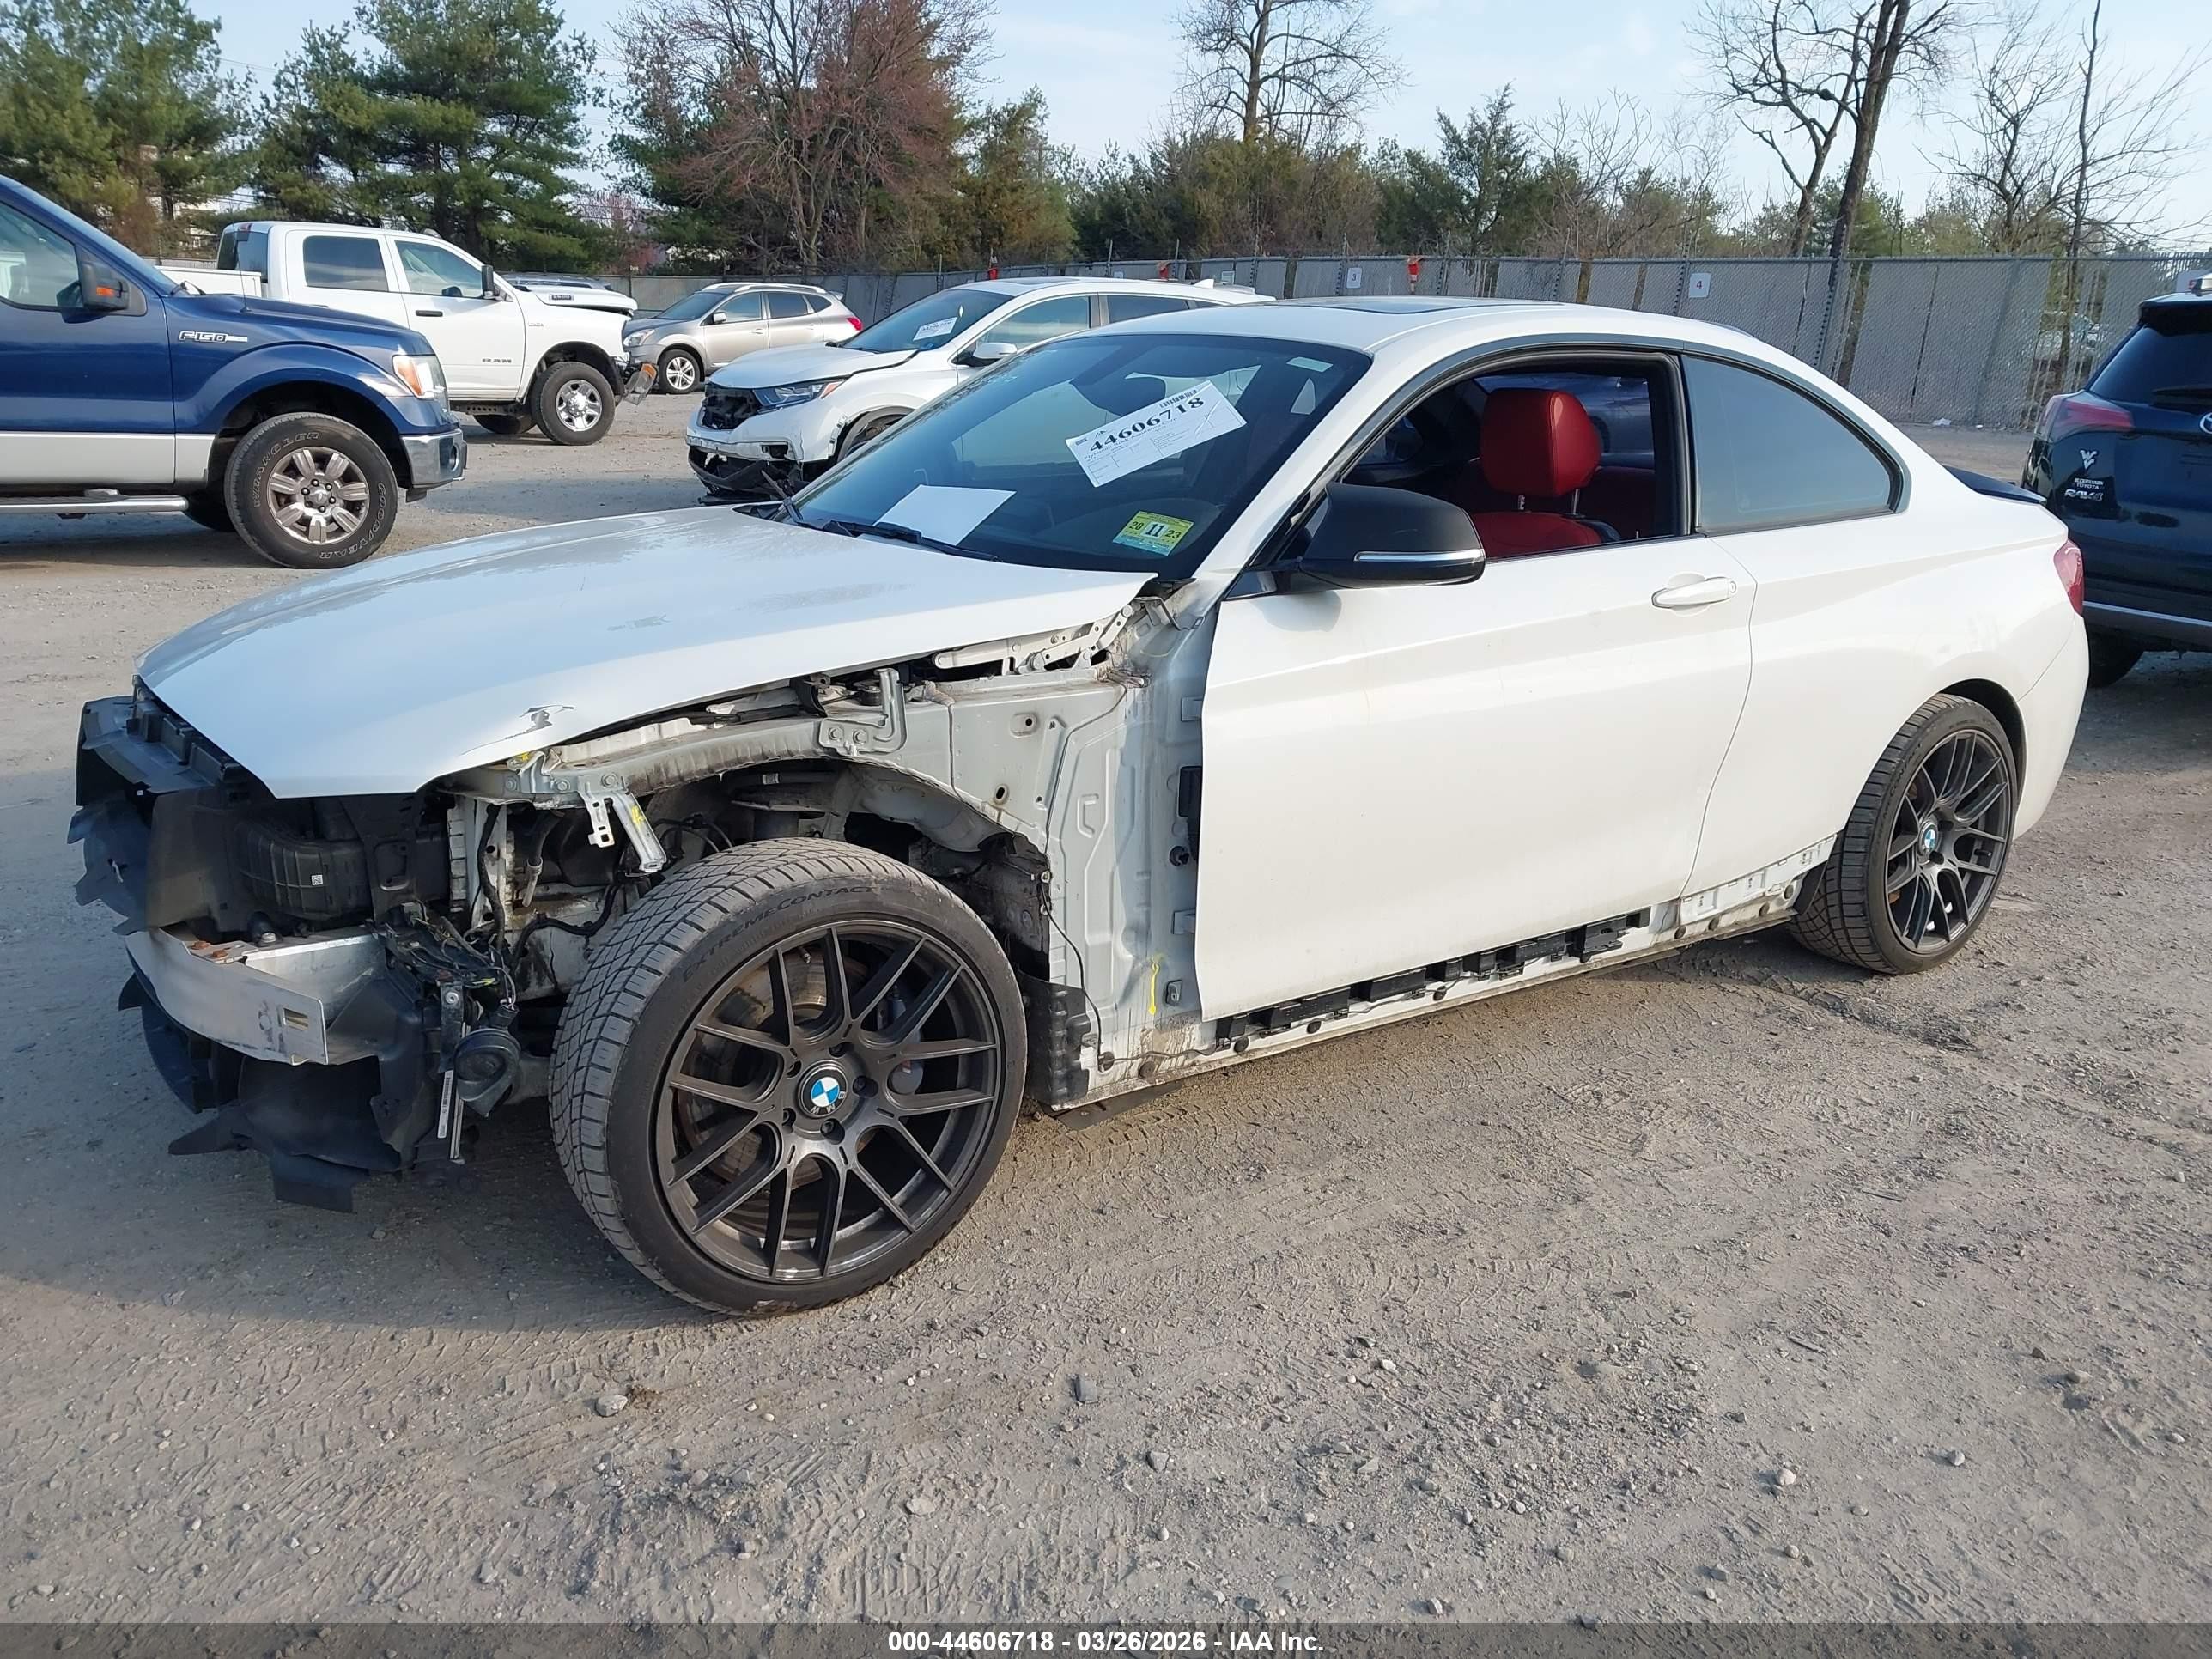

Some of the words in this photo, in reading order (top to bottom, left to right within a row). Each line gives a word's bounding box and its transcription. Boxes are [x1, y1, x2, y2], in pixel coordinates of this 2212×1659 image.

[1696, 280, 1703, 289] 4
[1090, 398, 1204, 452] 44606718
[252, 431, 320, 508] WRANGLER
[319, 482, 386, 559] GOODYEAR
[1128, 520, 1145, 531] 20
[1145, 523, 1165, 538] 11
[1164, 529, 1182, 539] 23
[810, 1091, 847, 1115] BMW
